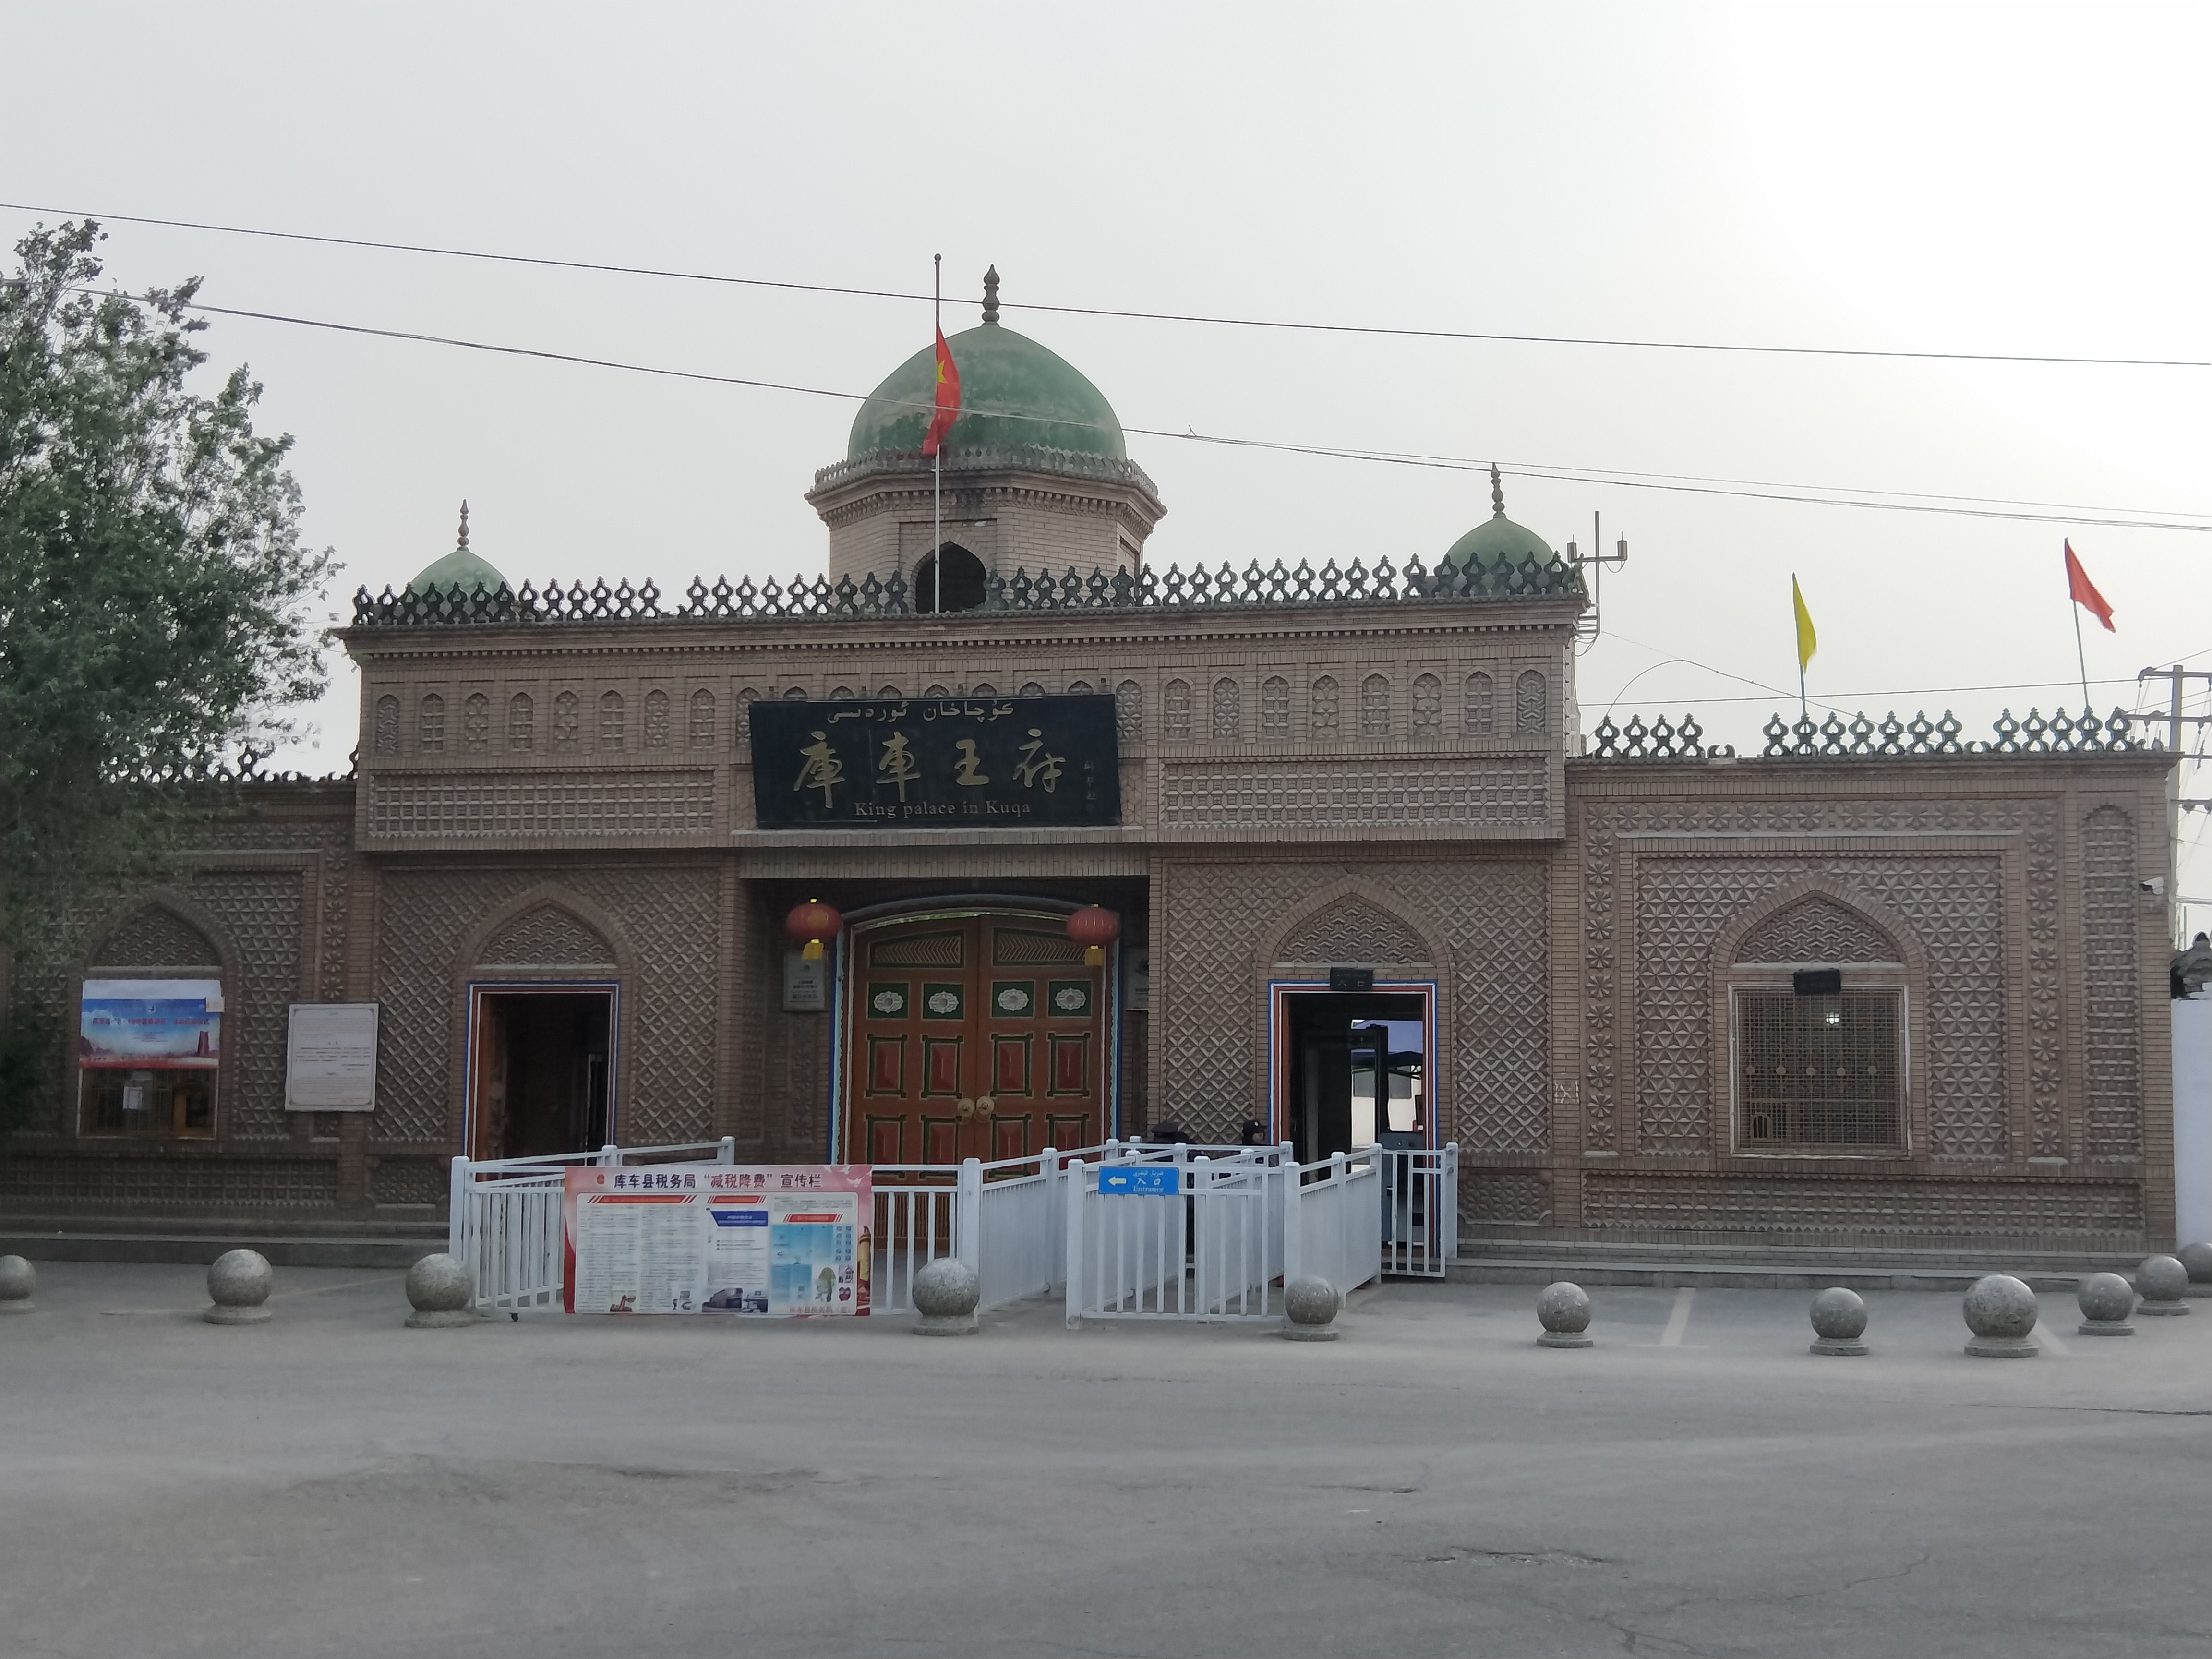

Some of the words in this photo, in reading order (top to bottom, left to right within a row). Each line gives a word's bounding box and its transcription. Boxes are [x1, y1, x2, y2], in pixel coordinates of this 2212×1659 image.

[854, 802, 897, 819] King
[903, 802, 956, 818] palace
[962, 801, 979, 814] in
[986, 800, 1030, 817] Kuqa
